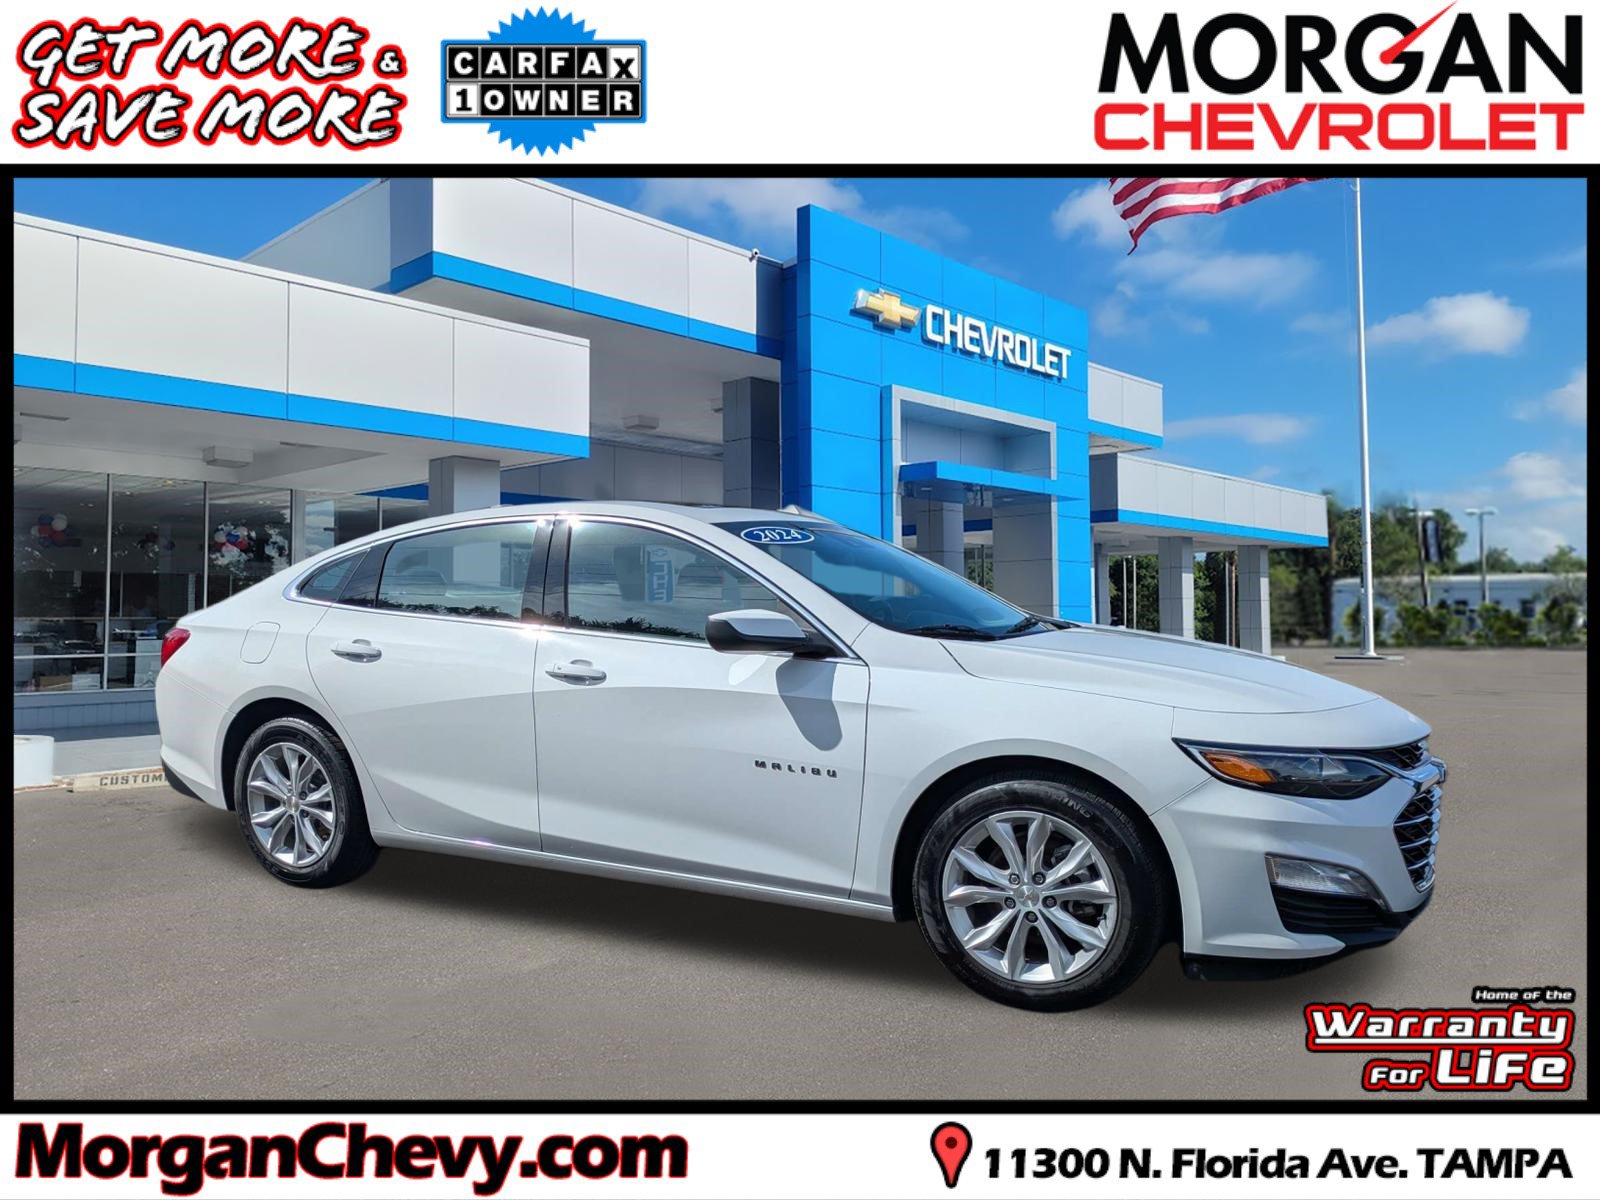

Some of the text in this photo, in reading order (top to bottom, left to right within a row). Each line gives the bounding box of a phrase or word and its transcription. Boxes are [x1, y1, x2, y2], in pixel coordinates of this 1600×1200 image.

[924, 304, 1071, 379] CHEVROLET
[753, 529, 802, 542] 2024
[755, 760, 838, 778] MALIBU
[100, 773, 167, 786] CUSTOM
